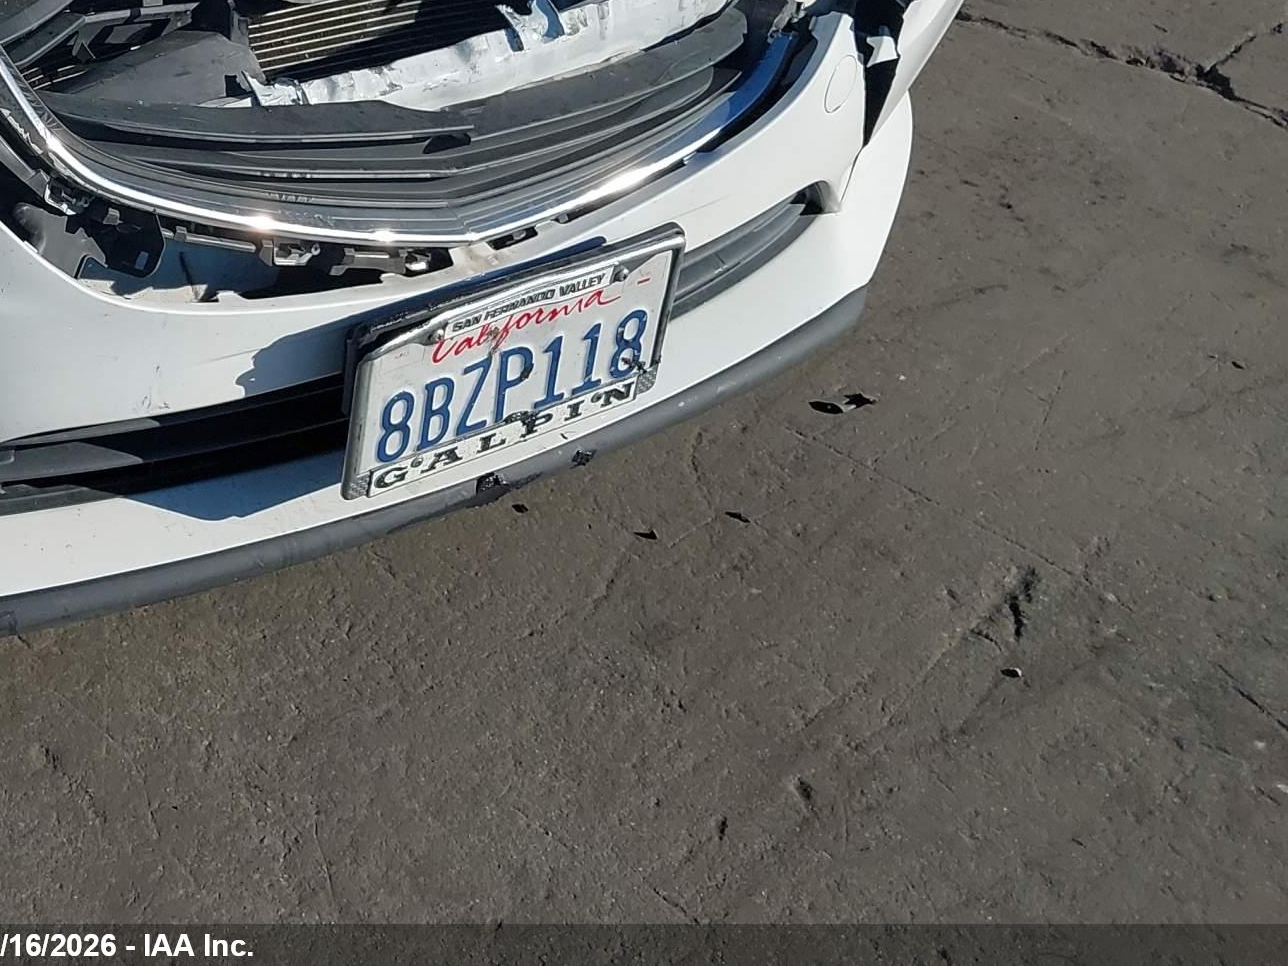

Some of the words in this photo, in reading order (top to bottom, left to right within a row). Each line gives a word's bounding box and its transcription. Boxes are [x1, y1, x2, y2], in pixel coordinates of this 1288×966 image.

[432, 288, 622, 363] California
[452, 315, 482, 333] SAN
[485, 288, 556, 324] FERNANDO
[558, 272, 606, 297] VALLEY
[376, 309, 648, 464] 8BZP118
[373, 382, 633, 489] GALPIN
